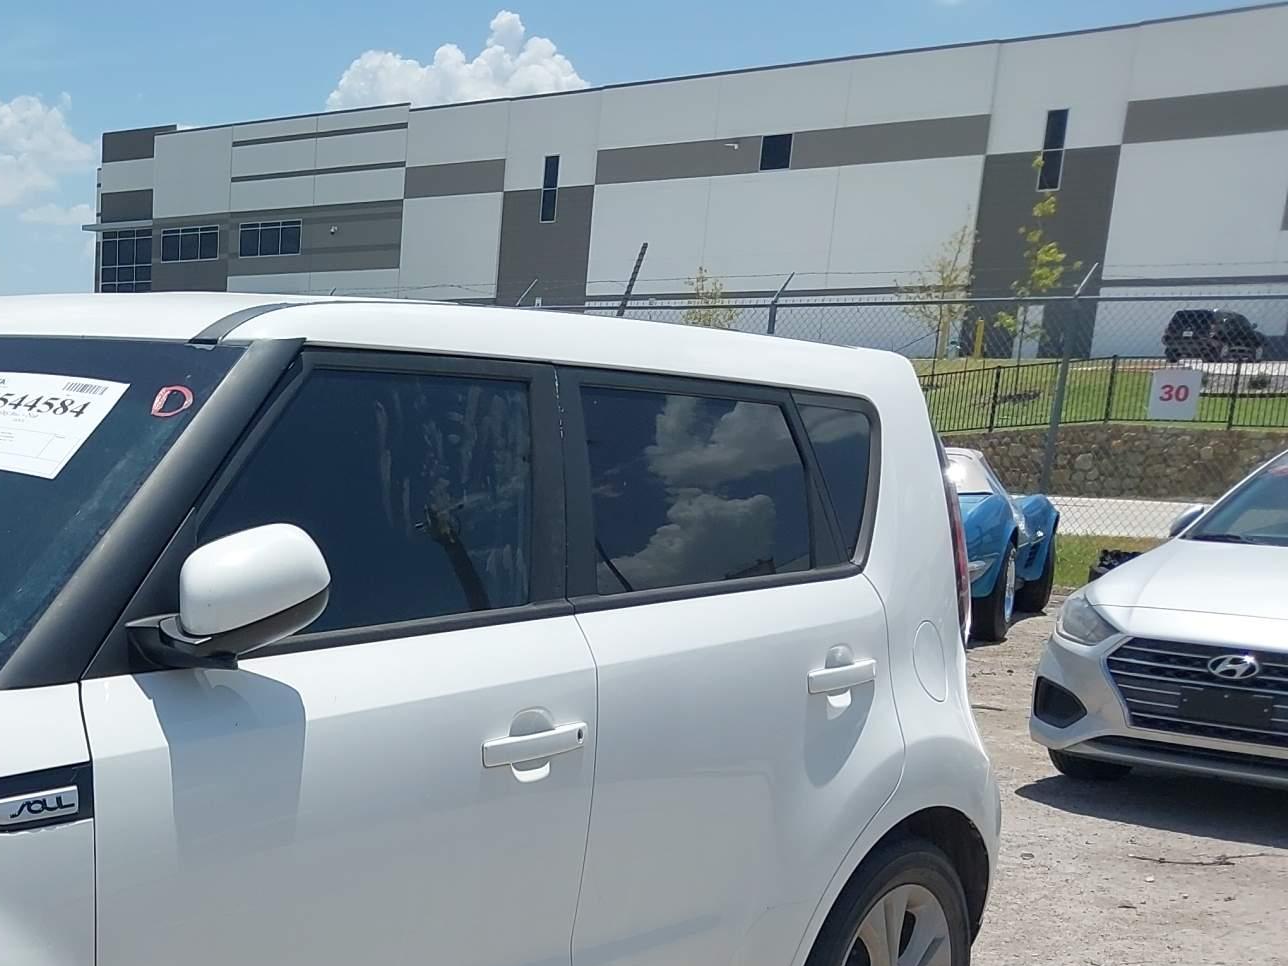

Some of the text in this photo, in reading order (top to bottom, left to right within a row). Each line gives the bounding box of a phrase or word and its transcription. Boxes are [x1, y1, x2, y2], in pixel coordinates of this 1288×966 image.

[150, 384, 194, 418] D
[1159, 384, 1190, 402] 30
[9, 795, 75, 819] SOUL
